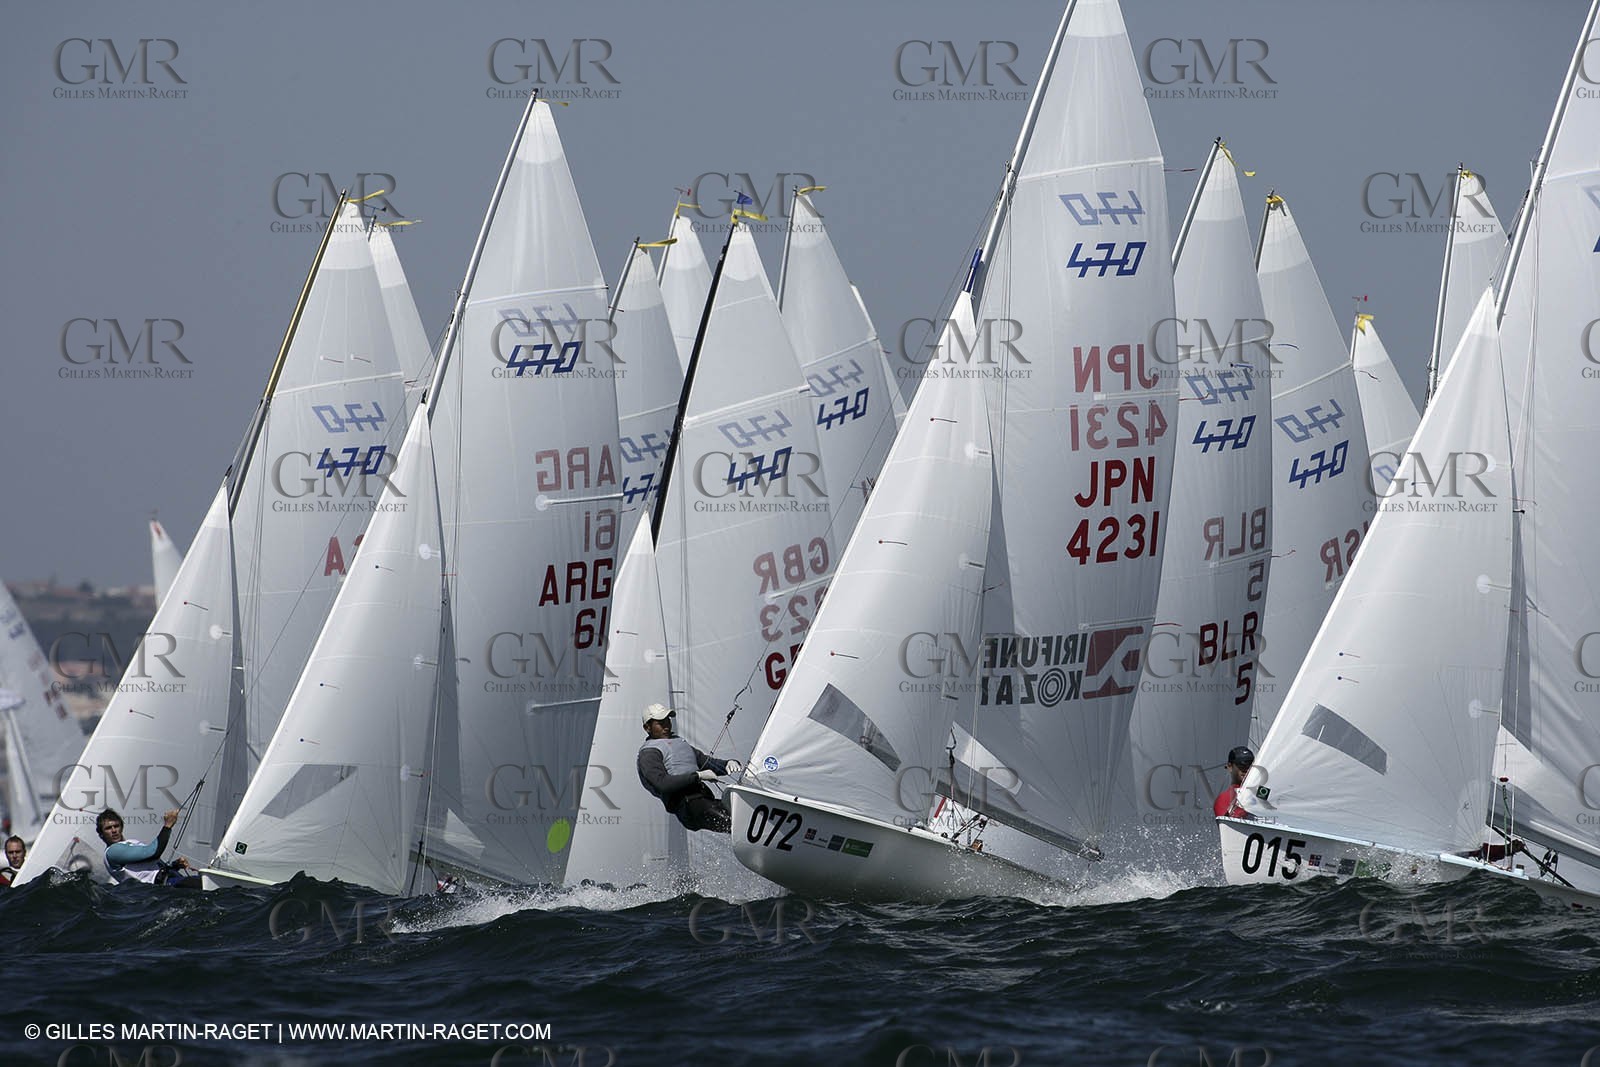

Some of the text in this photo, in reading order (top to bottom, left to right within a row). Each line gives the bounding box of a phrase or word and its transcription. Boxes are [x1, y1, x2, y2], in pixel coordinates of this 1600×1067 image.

[1066, 241, 1147, 279] 470
[506, 341, 583, 377] 470
[816, 387, 869, 430] 470
[1192, 415, 1257, 453] 470
[316, 445, 388, 478] 470
[727, 446, 792, 491] 470
[1074, 456, 1156, 508] JPN
[1288, 440, 1349, 489] 470
[1066, 511, 1161, 565] 4231
[539, 558, 614, 607] ARG
[1198, 611, 1258, 667] BLR
[1235, 661, 1253, 706] 5
[746, 804, 803, 851] 072
[1242, 833, 1306, 880] 015
